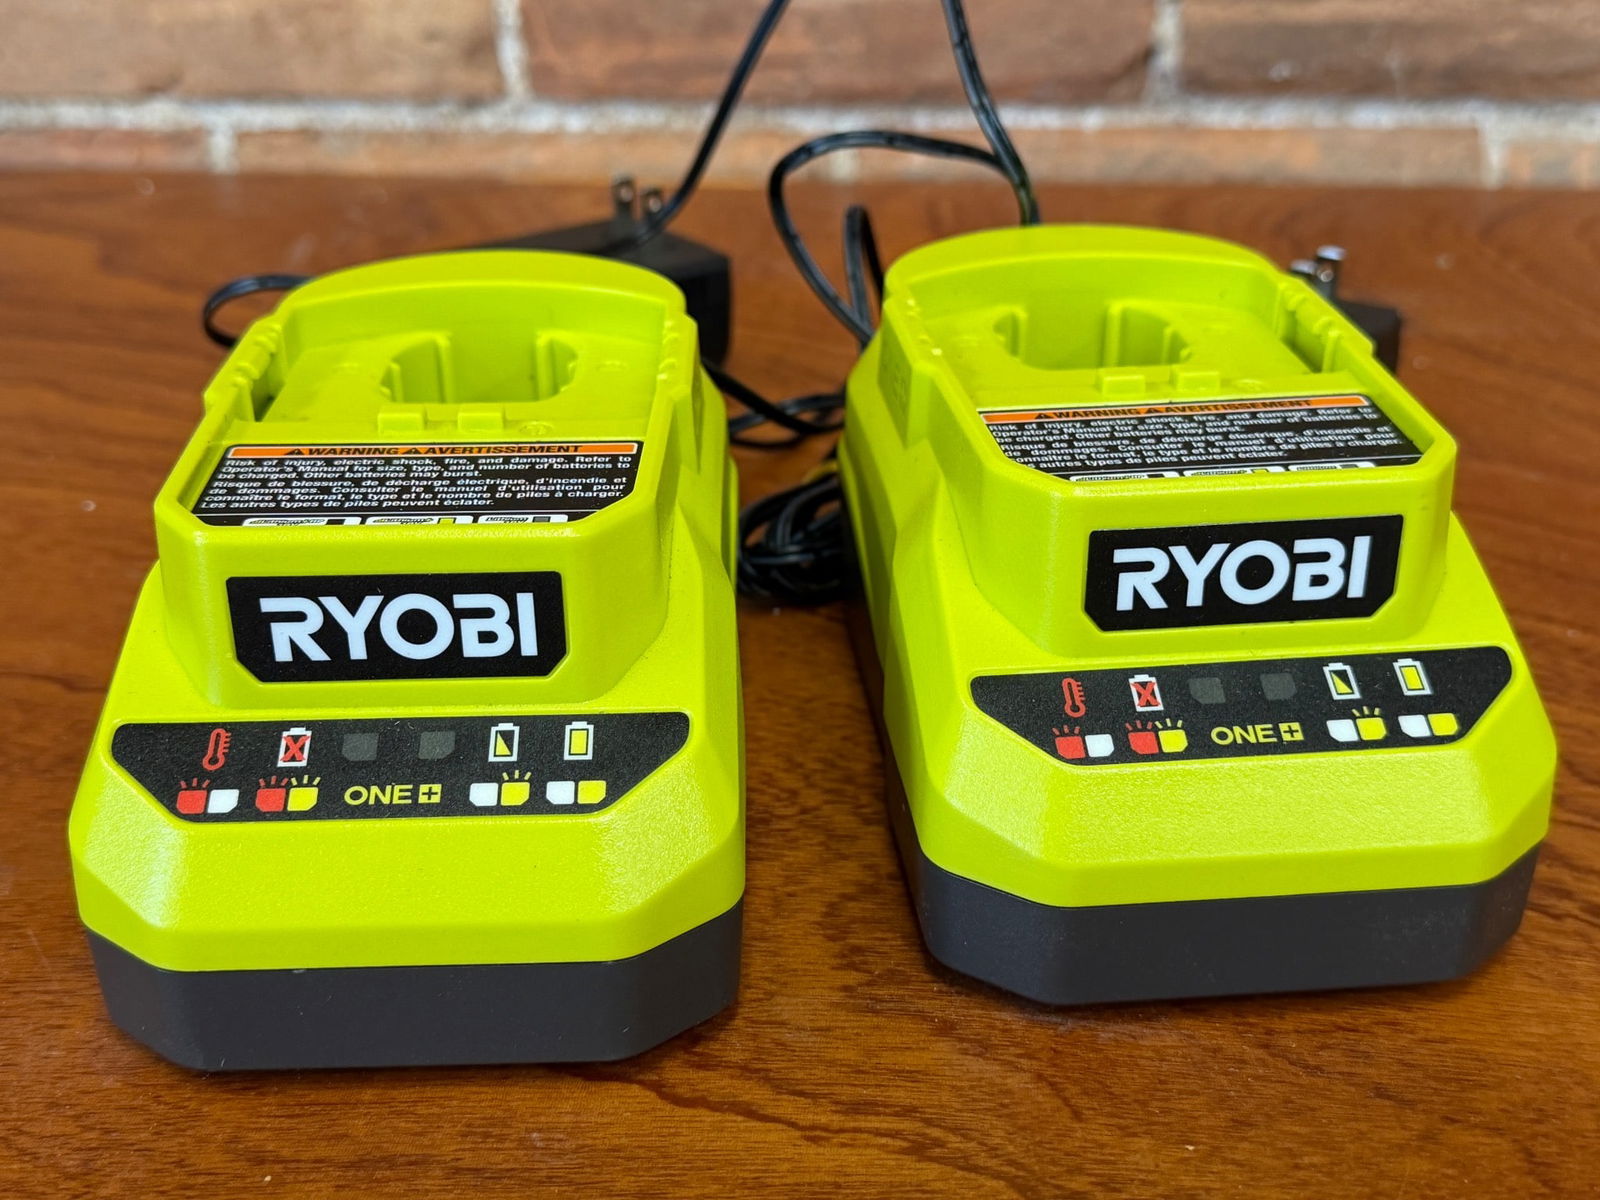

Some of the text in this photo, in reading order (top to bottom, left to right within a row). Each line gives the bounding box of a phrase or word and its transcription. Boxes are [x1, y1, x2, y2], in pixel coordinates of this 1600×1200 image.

[1052, 400, 1311, 419] WARNING AVERTISSEMENT
[427, 446, 583, 454] AVERTISSEMENT
[1112, 536, 1372, 611] RYOBI
[260, 592, 538, 662] RYOBI
